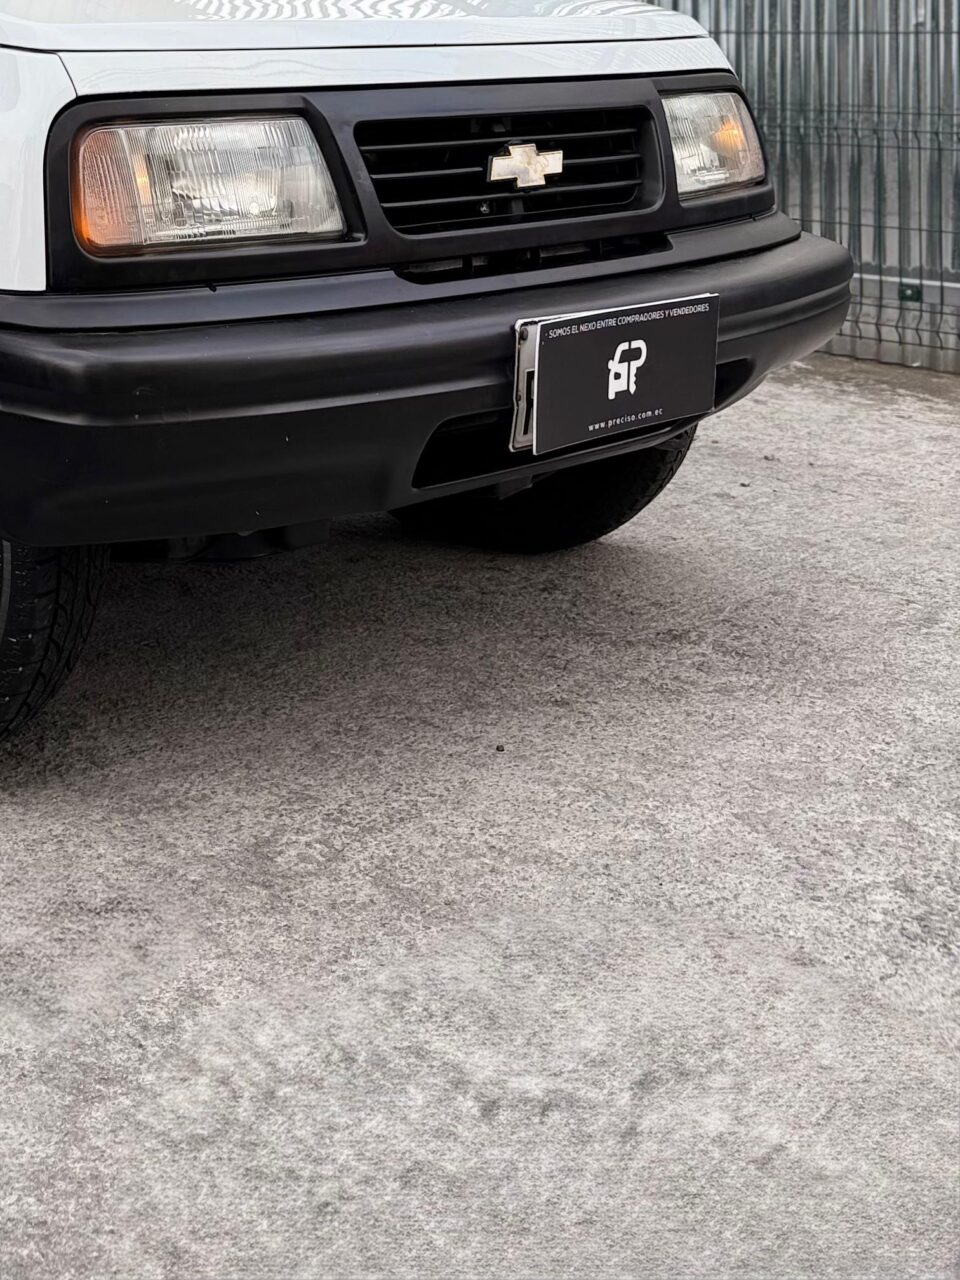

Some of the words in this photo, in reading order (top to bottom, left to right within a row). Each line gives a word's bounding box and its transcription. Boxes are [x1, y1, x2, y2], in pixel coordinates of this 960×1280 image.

[548, 326, 571, 339] SOMOS
[571, 324, 579, 335] EL
[579, 321, 597, 332] NEXO
[596, 317, 617, 330] ENTRE
[617, 309, 664, 326] COMPRADORES
[664, 309, 670, 319] Y
[669, 303, 710, 317] VENDEDORES
[588, 408, 663, 431] www.preciso.com.ec
